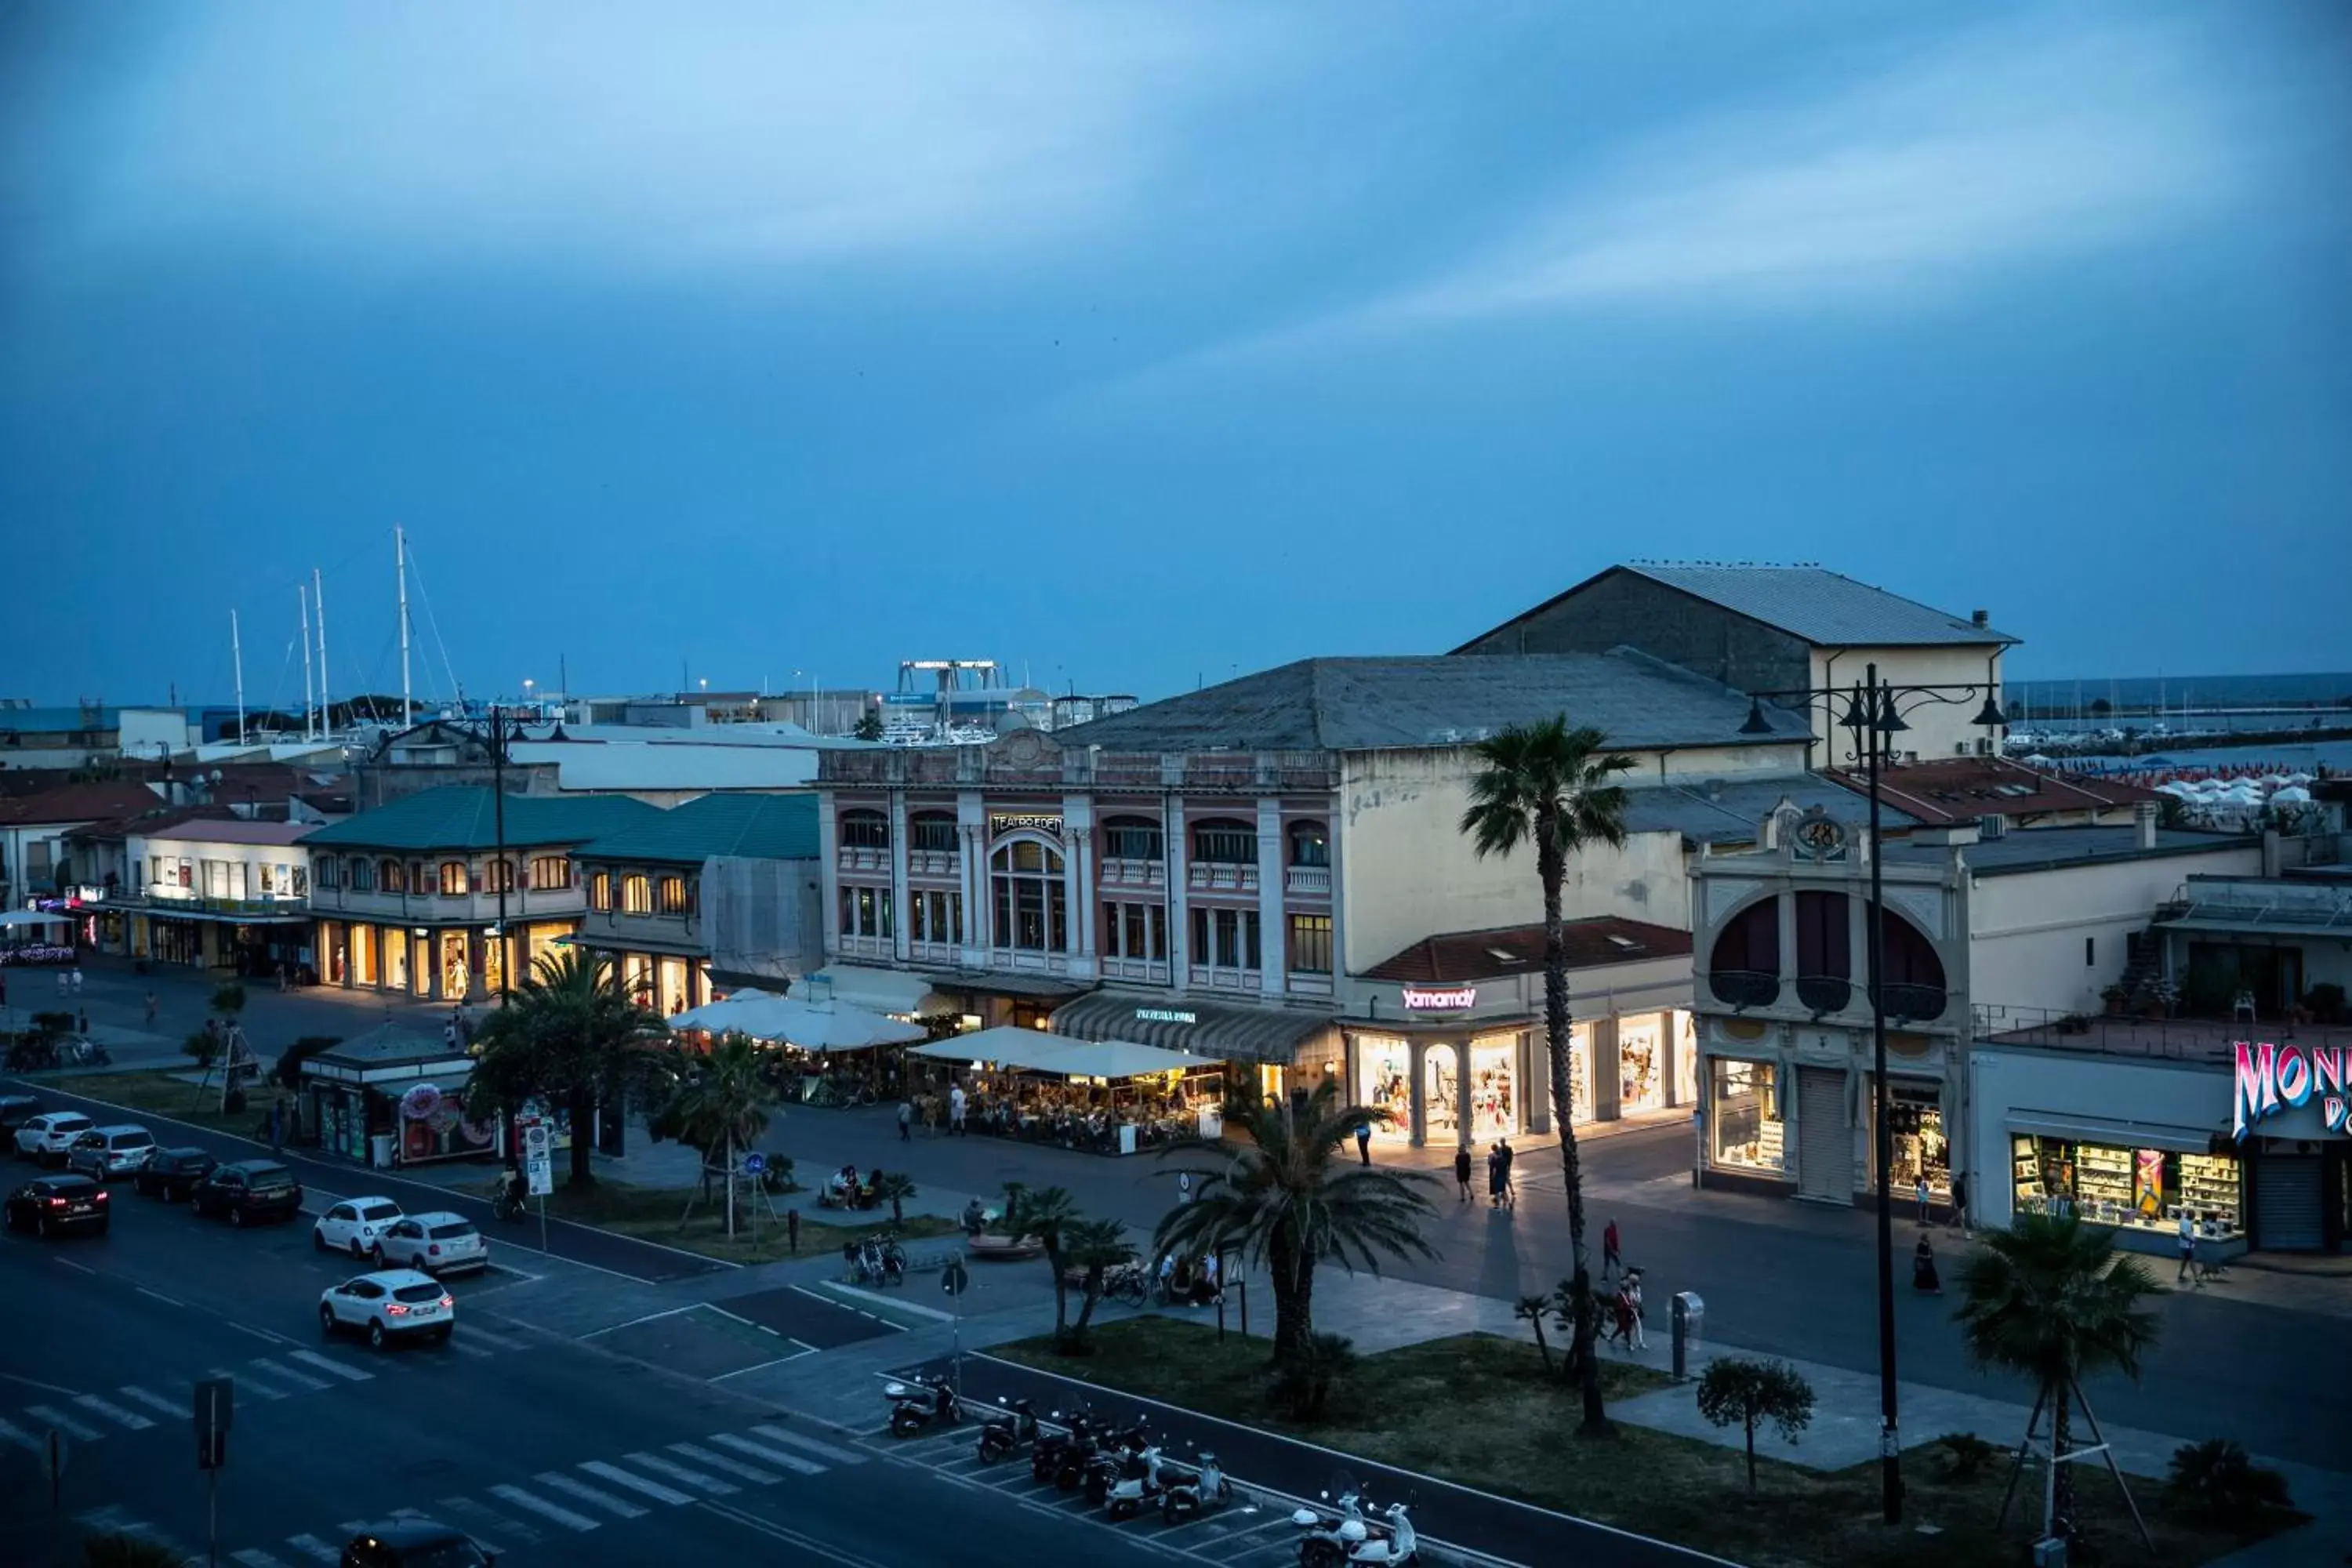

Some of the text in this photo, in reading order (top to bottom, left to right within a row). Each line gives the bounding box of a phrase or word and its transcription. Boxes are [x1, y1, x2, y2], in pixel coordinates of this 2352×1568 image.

[993, 816, 1062, 833] TEATRO EDEN
[2232, 1041, 2352, 1139] MON
